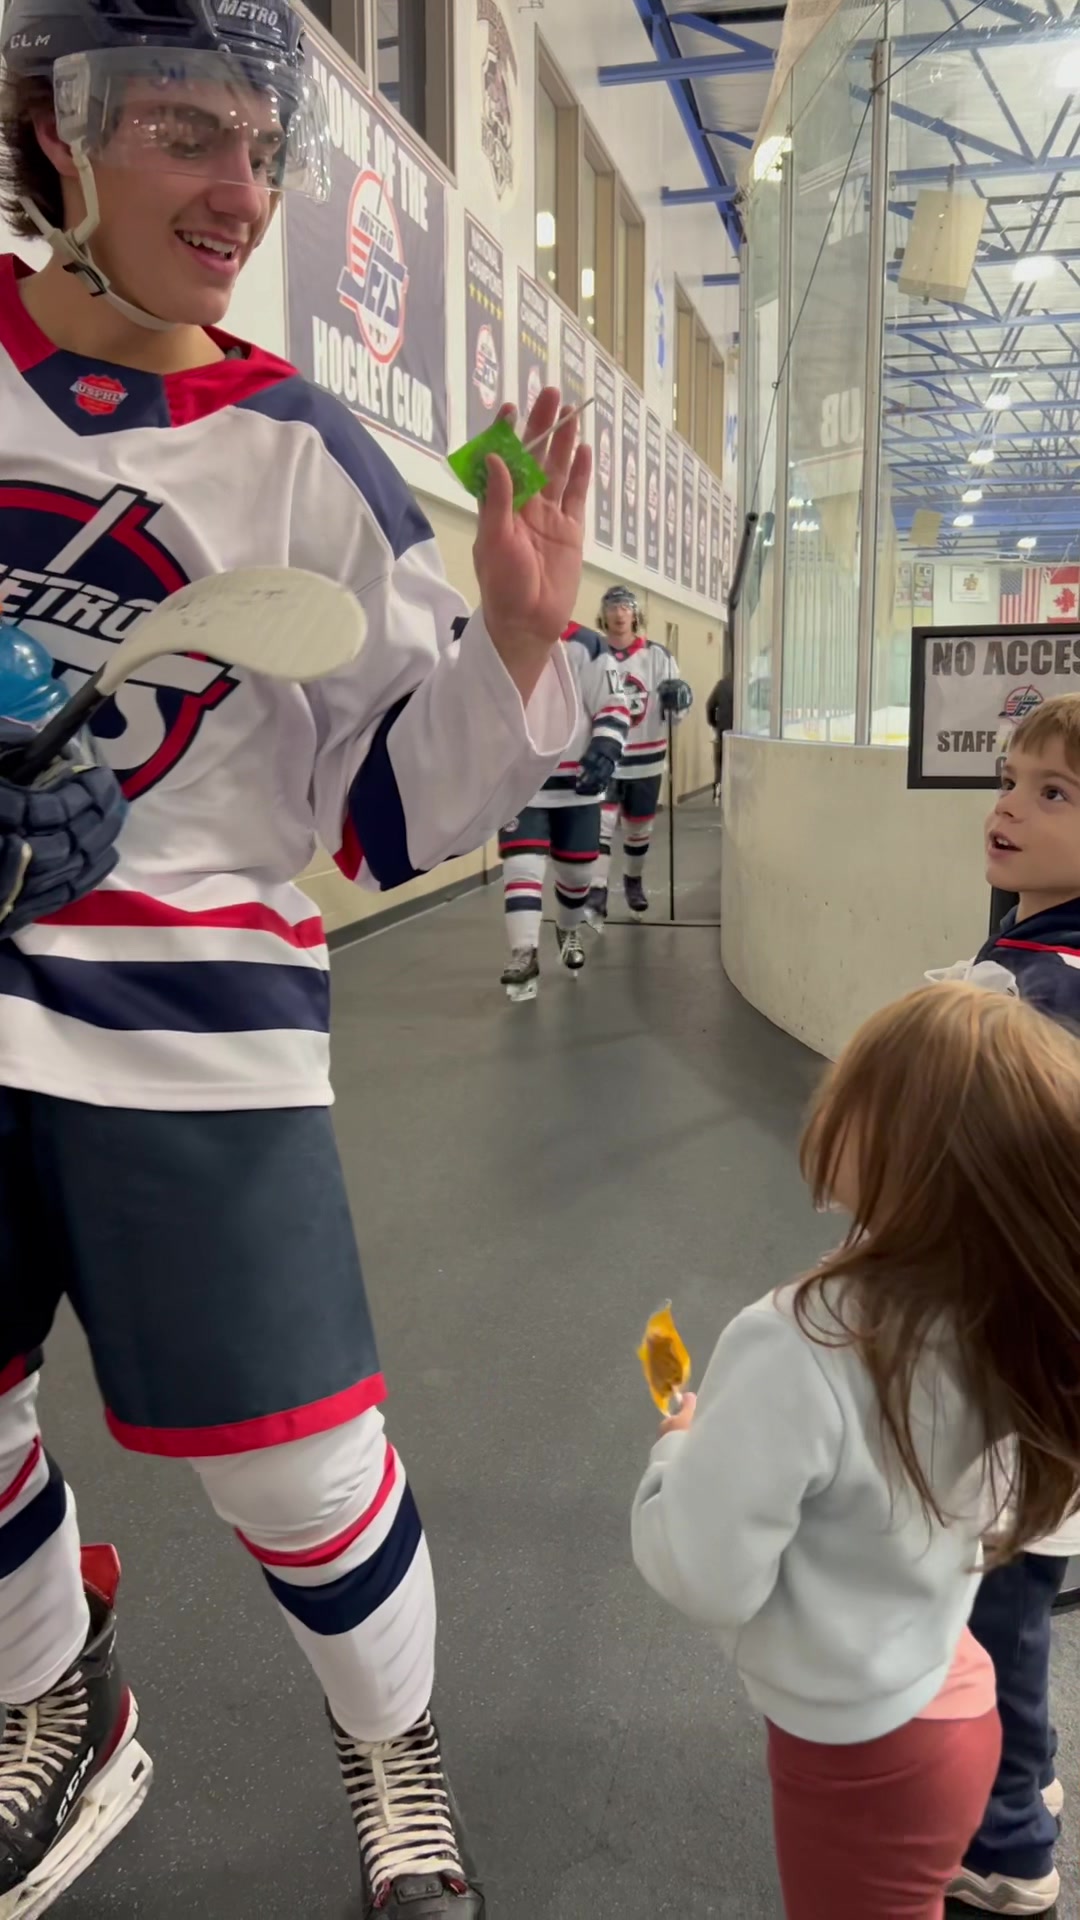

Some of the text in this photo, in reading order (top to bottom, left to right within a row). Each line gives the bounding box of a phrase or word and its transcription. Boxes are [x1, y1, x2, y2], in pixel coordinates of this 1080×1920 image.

[217, 0, 279, 26] METRO
[398, 146, 428, 232] THE
[312, 315, 433, 442] HOCKEY CLUB
[0, 563, 160, 640] ETRO
[932, 641, 976, 676] NO
[937, 730, 997, 753] STAFF
